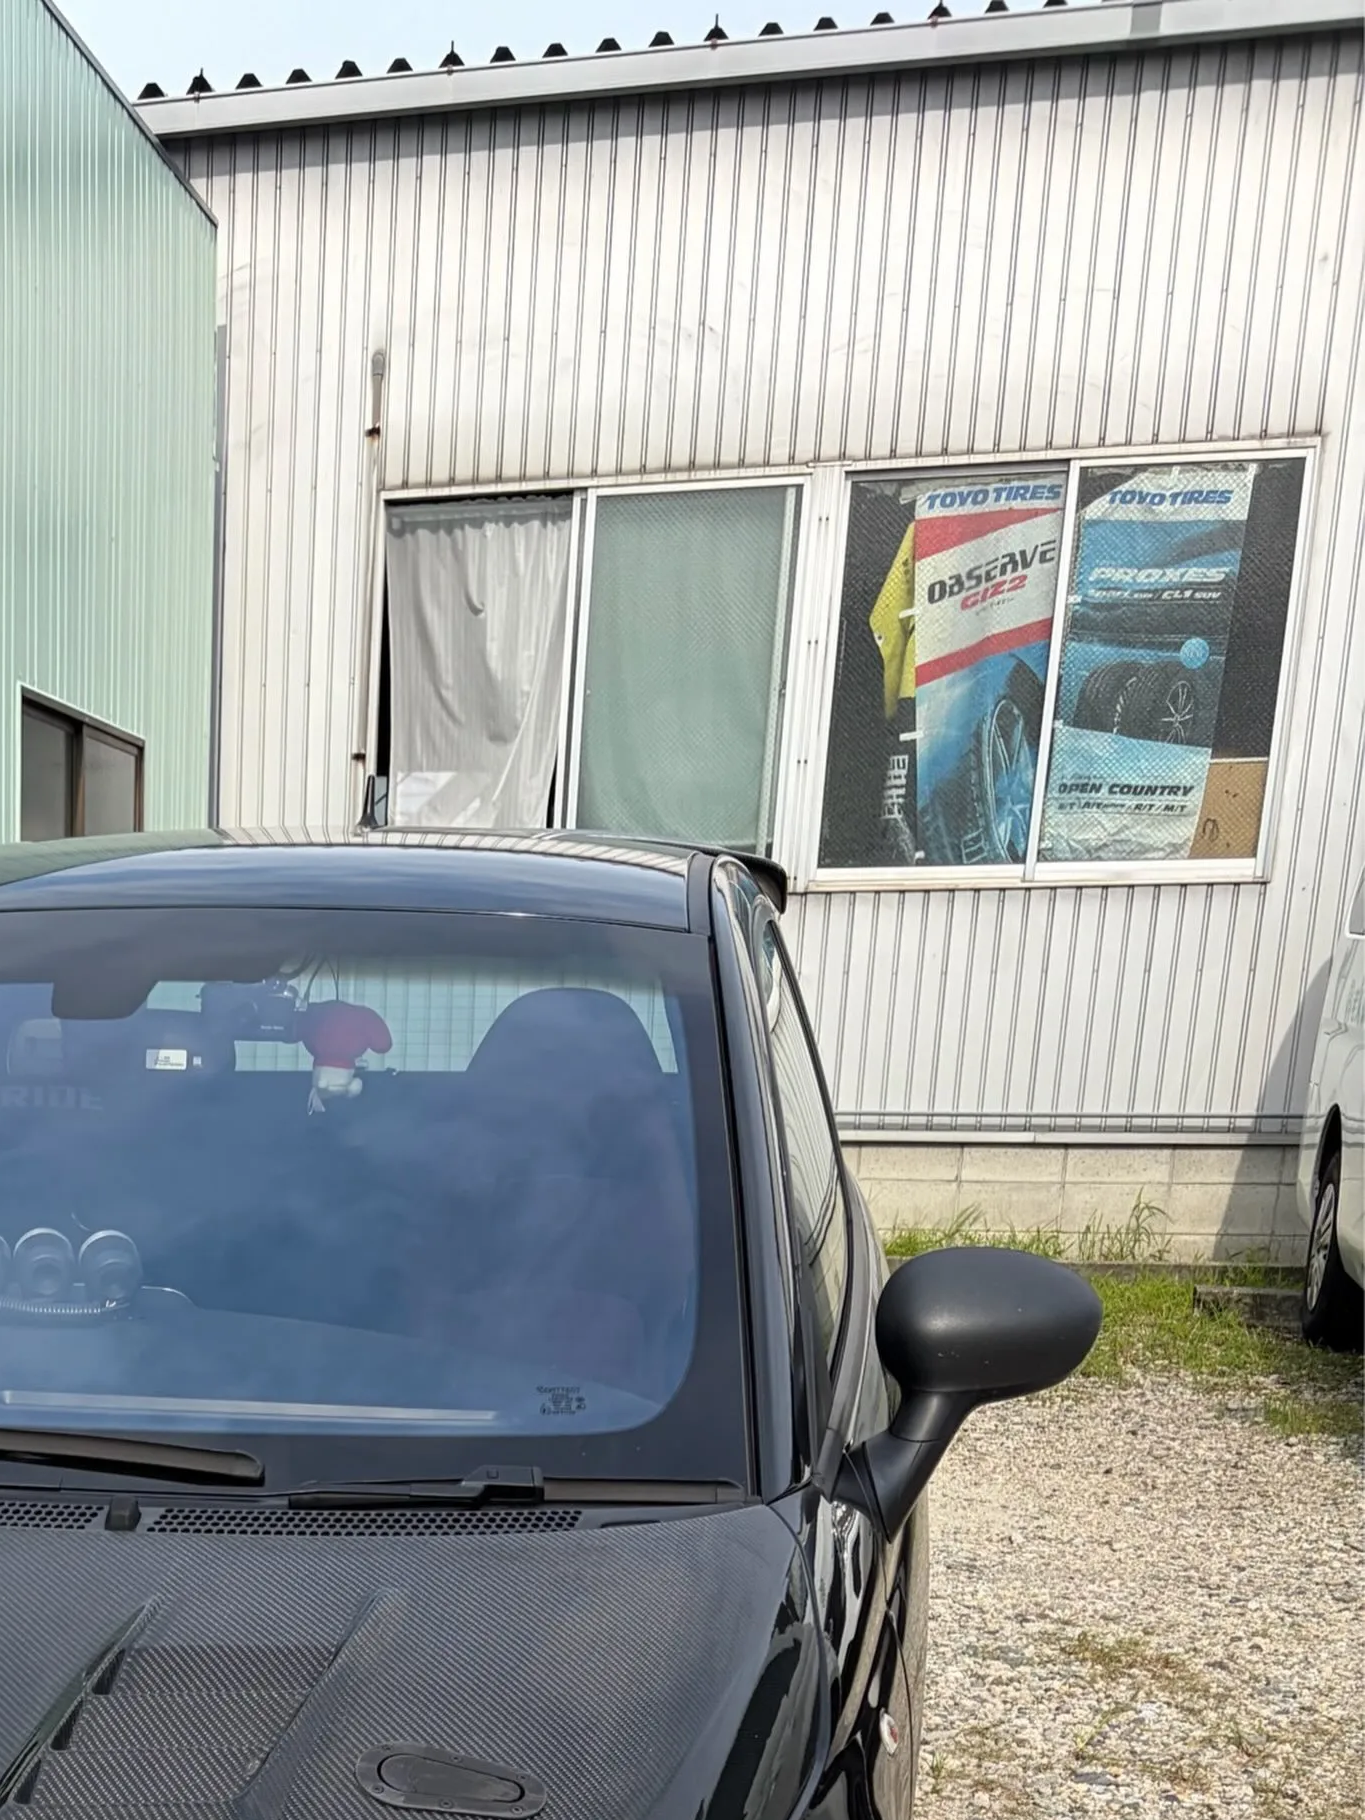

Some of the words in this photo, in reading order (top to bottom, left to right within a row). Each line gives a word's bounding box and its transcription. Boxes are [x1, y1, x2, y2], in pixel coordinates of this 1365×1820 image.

[926, 488, 990, 511] TOYO
[992, 484, 1063, 503] TIRES
[1109, 489, 1167, 506] TOYO
[1169, 489, 1234, 505] TIRES
[927, 540, 1057, 605] OBSERVE
[1088, 567, 1231, 583] PROXES
[1058, 783, 1103, 795] OPEN
[1108, 783, 1194, 797] COUNTRY
